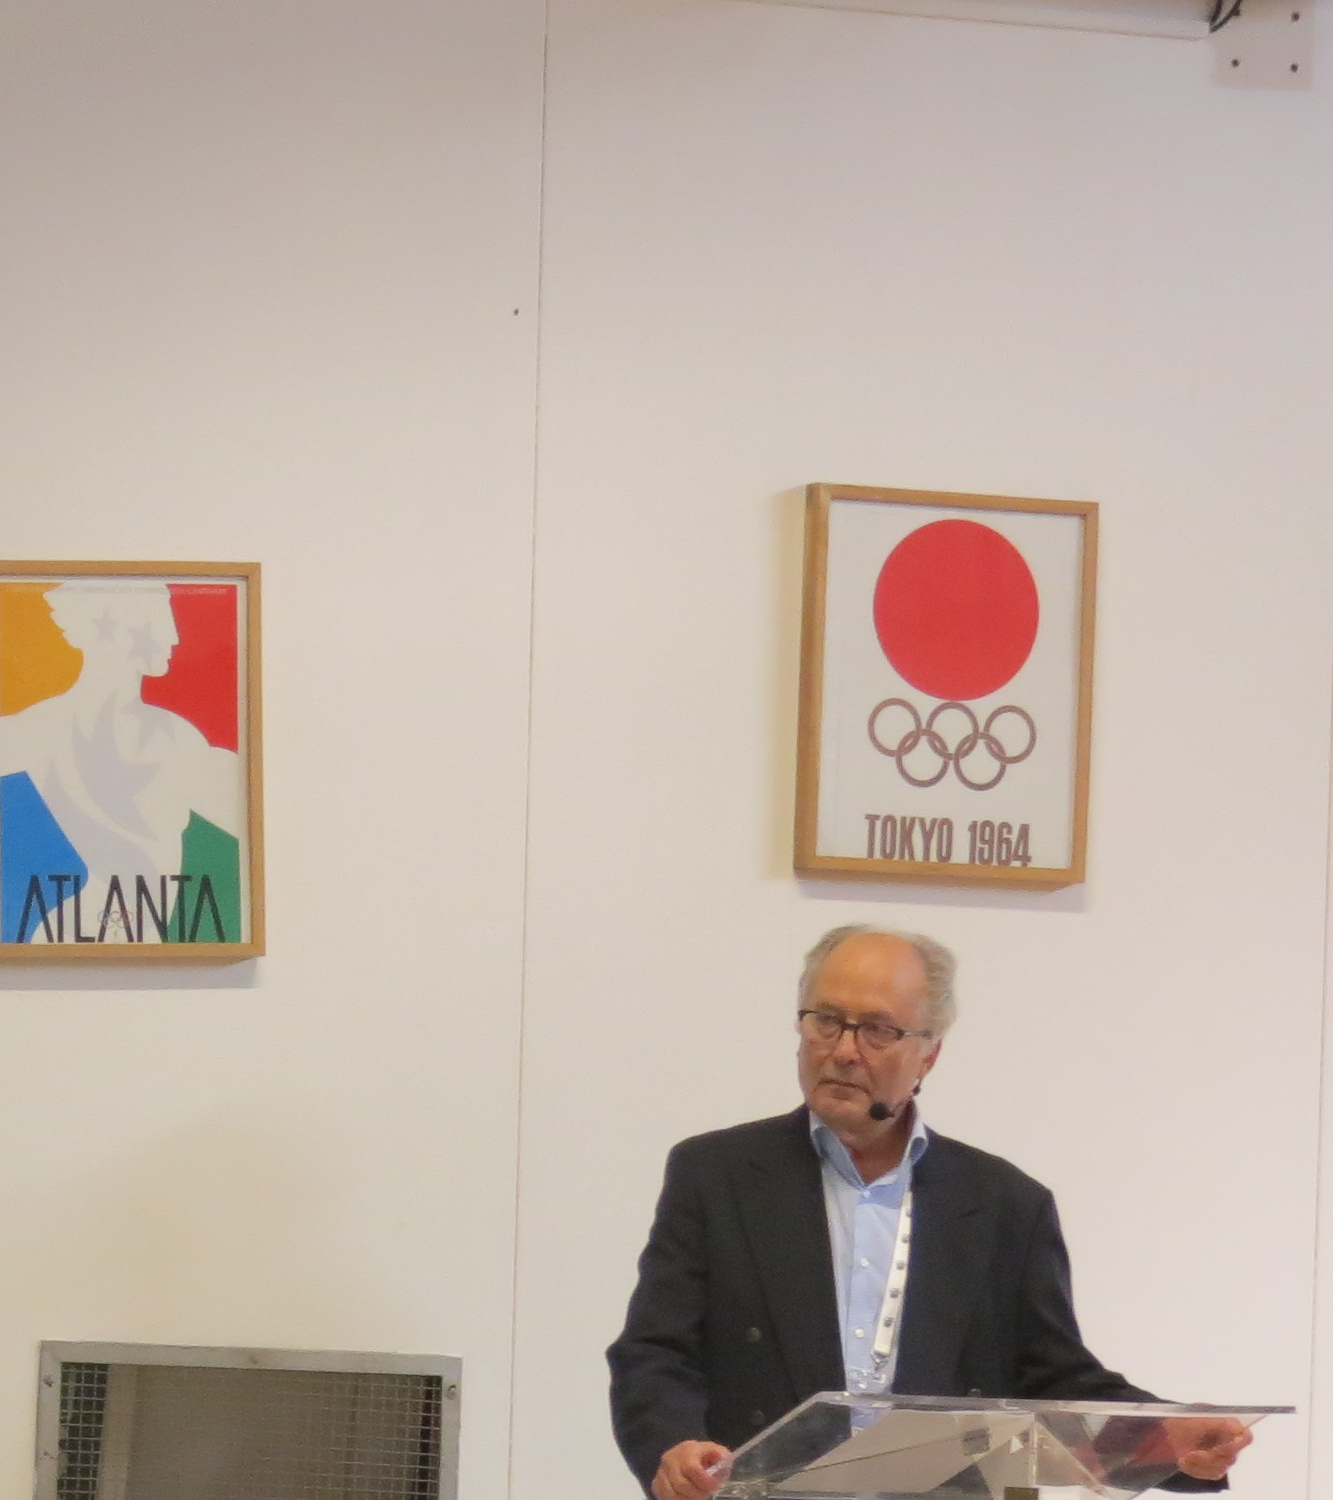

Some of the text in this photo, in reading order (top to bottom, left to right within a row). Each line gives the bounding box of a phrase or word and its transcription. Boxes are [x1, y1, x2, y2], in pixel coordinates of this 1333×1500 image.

[865, 814, 1032, 867] TOKYO 1964
[17, 874, 226, 943] ATLANTA
